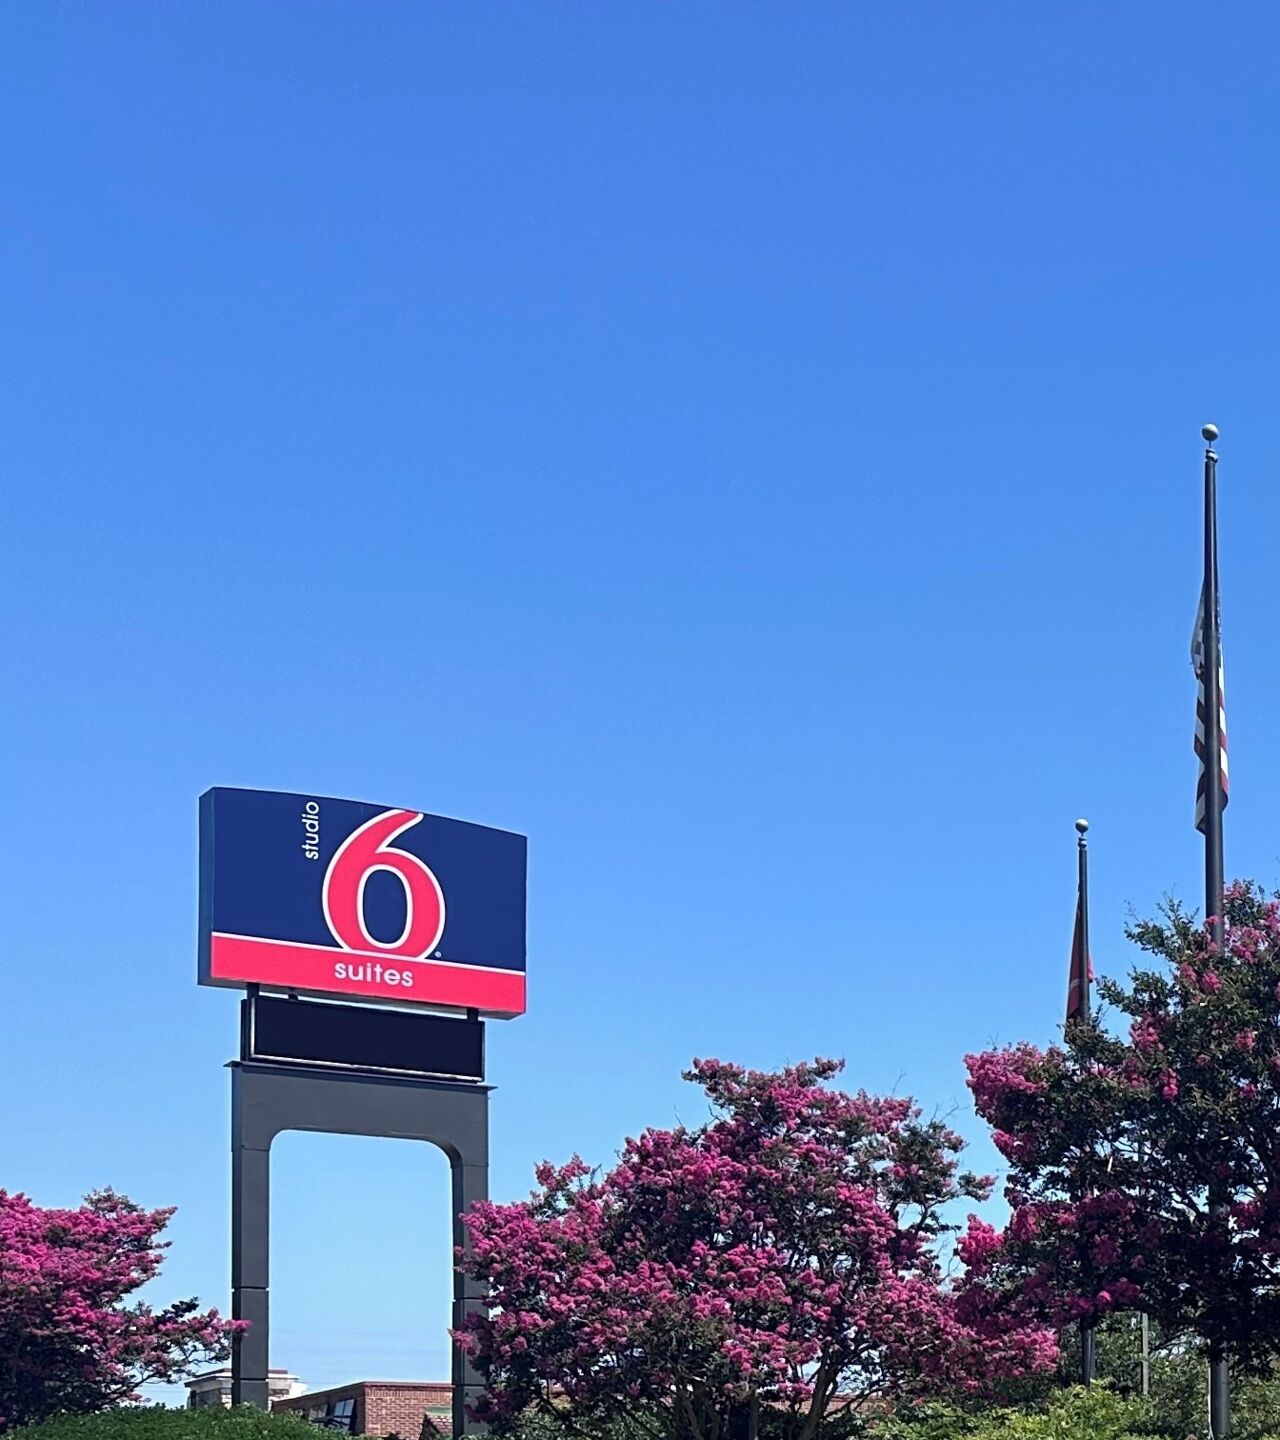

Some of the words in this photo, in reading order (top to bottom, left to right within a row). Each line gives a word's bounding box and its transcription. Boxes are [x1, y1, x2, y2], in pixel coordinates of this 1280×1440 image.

[301, 801, 320, 860] studio
[322, 809, 446, 960] 6
[334, 962, 414, 987] suites
